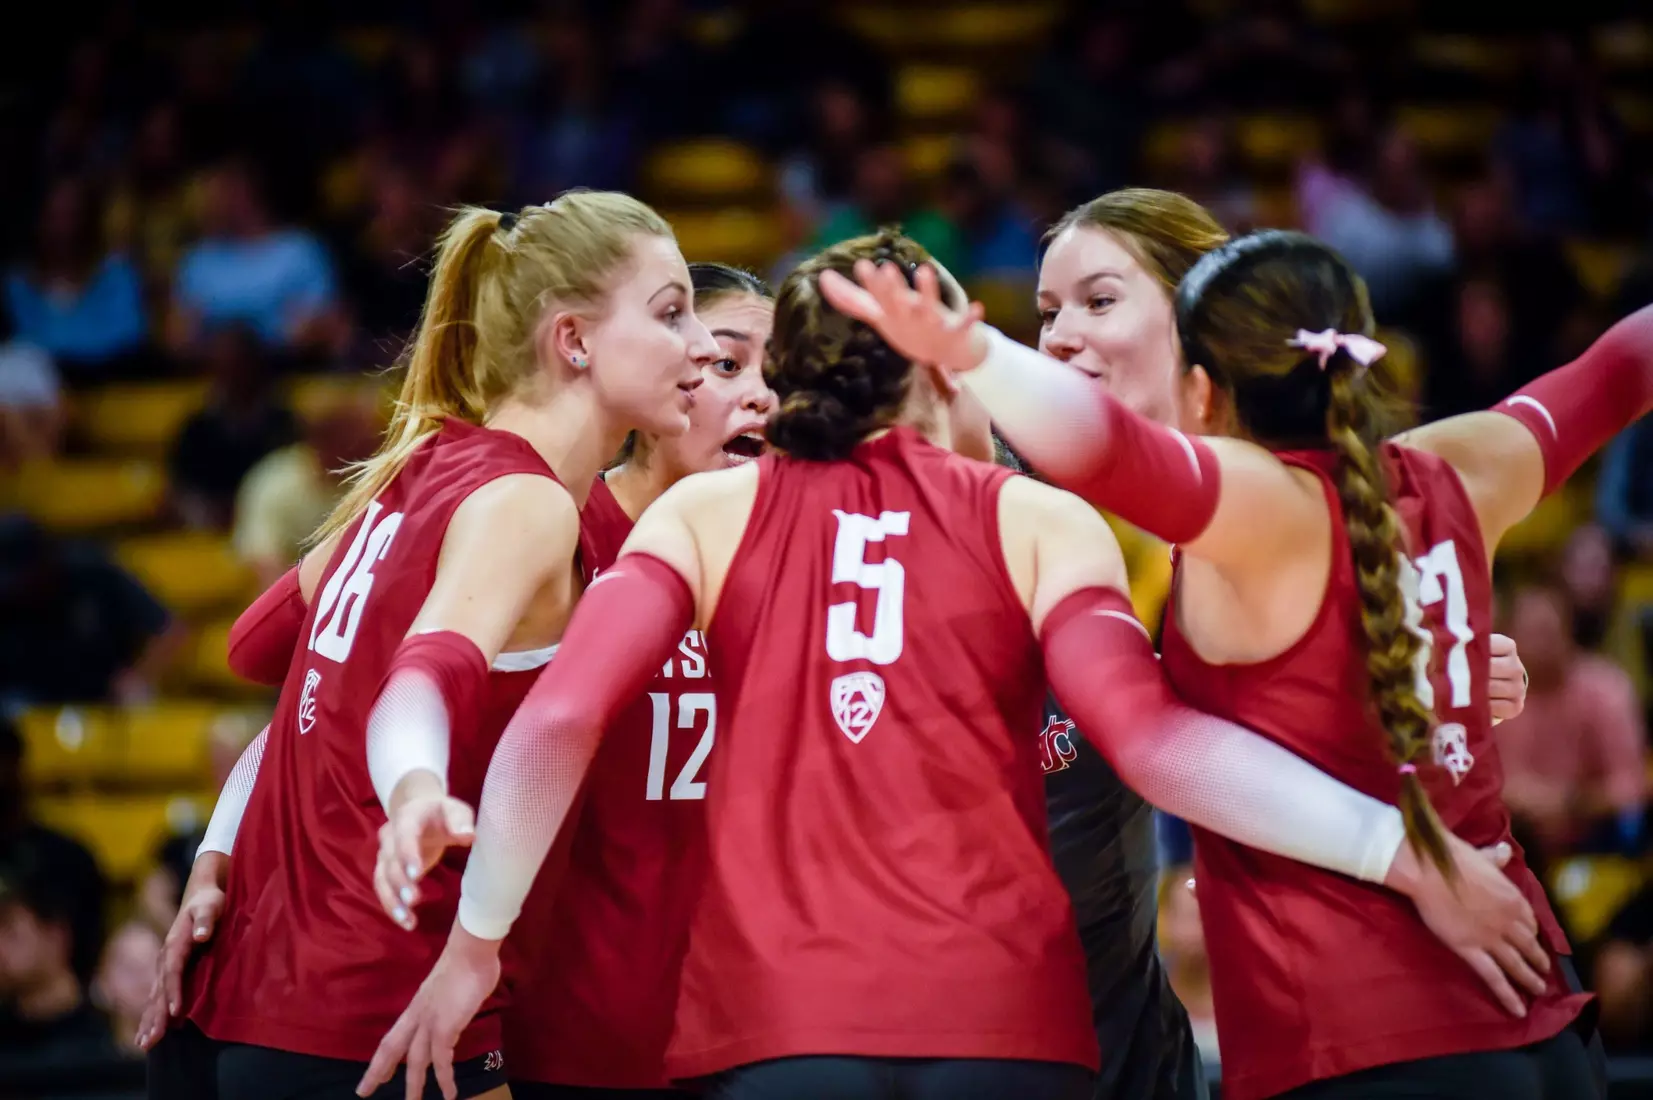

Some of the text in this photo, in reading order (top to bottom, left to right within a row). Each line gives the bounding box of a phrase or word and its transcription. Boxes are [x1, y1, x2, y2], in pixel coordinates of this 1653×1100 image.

[307, 499, 405, 664] 16
[826, 509, 911, 665] 5
[645, 692, 717, 801] 12
